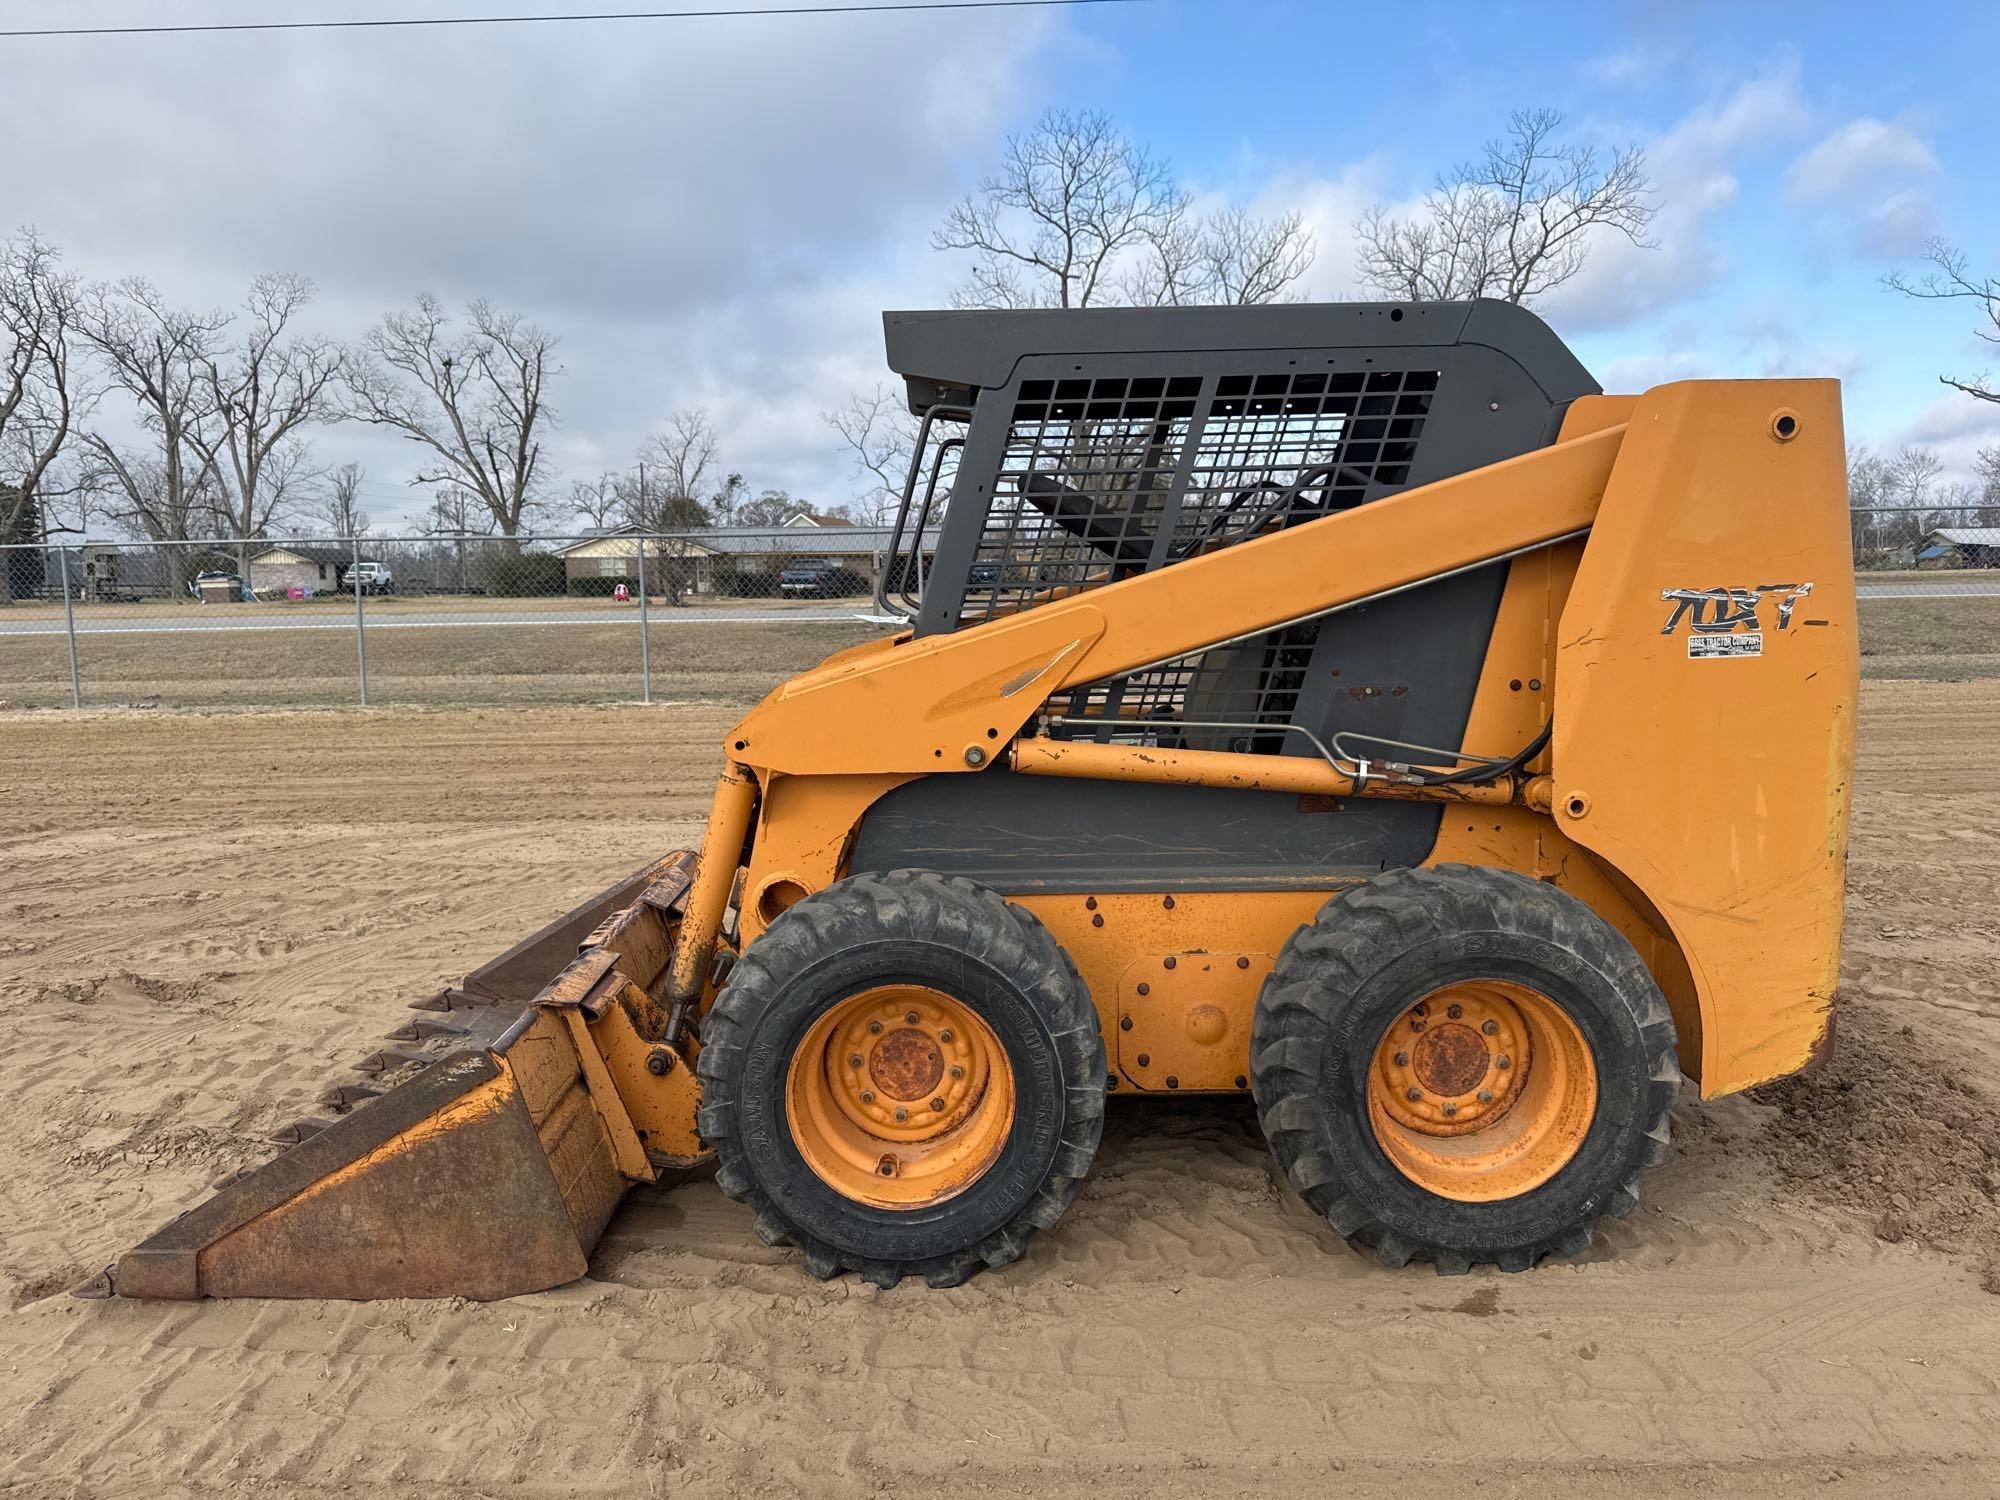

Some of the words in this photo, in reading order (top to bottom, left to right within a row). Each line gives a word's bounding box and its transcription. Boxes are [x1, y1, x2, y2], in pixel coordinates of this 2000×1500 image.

[1706, 636, 1731, 647] TRACTOR
[745, 1040, 772, 1163] SAMSON
[986, 983, 1054, 1084] PREMIUM
[1032, 1093, 1054, 1148] SKID
